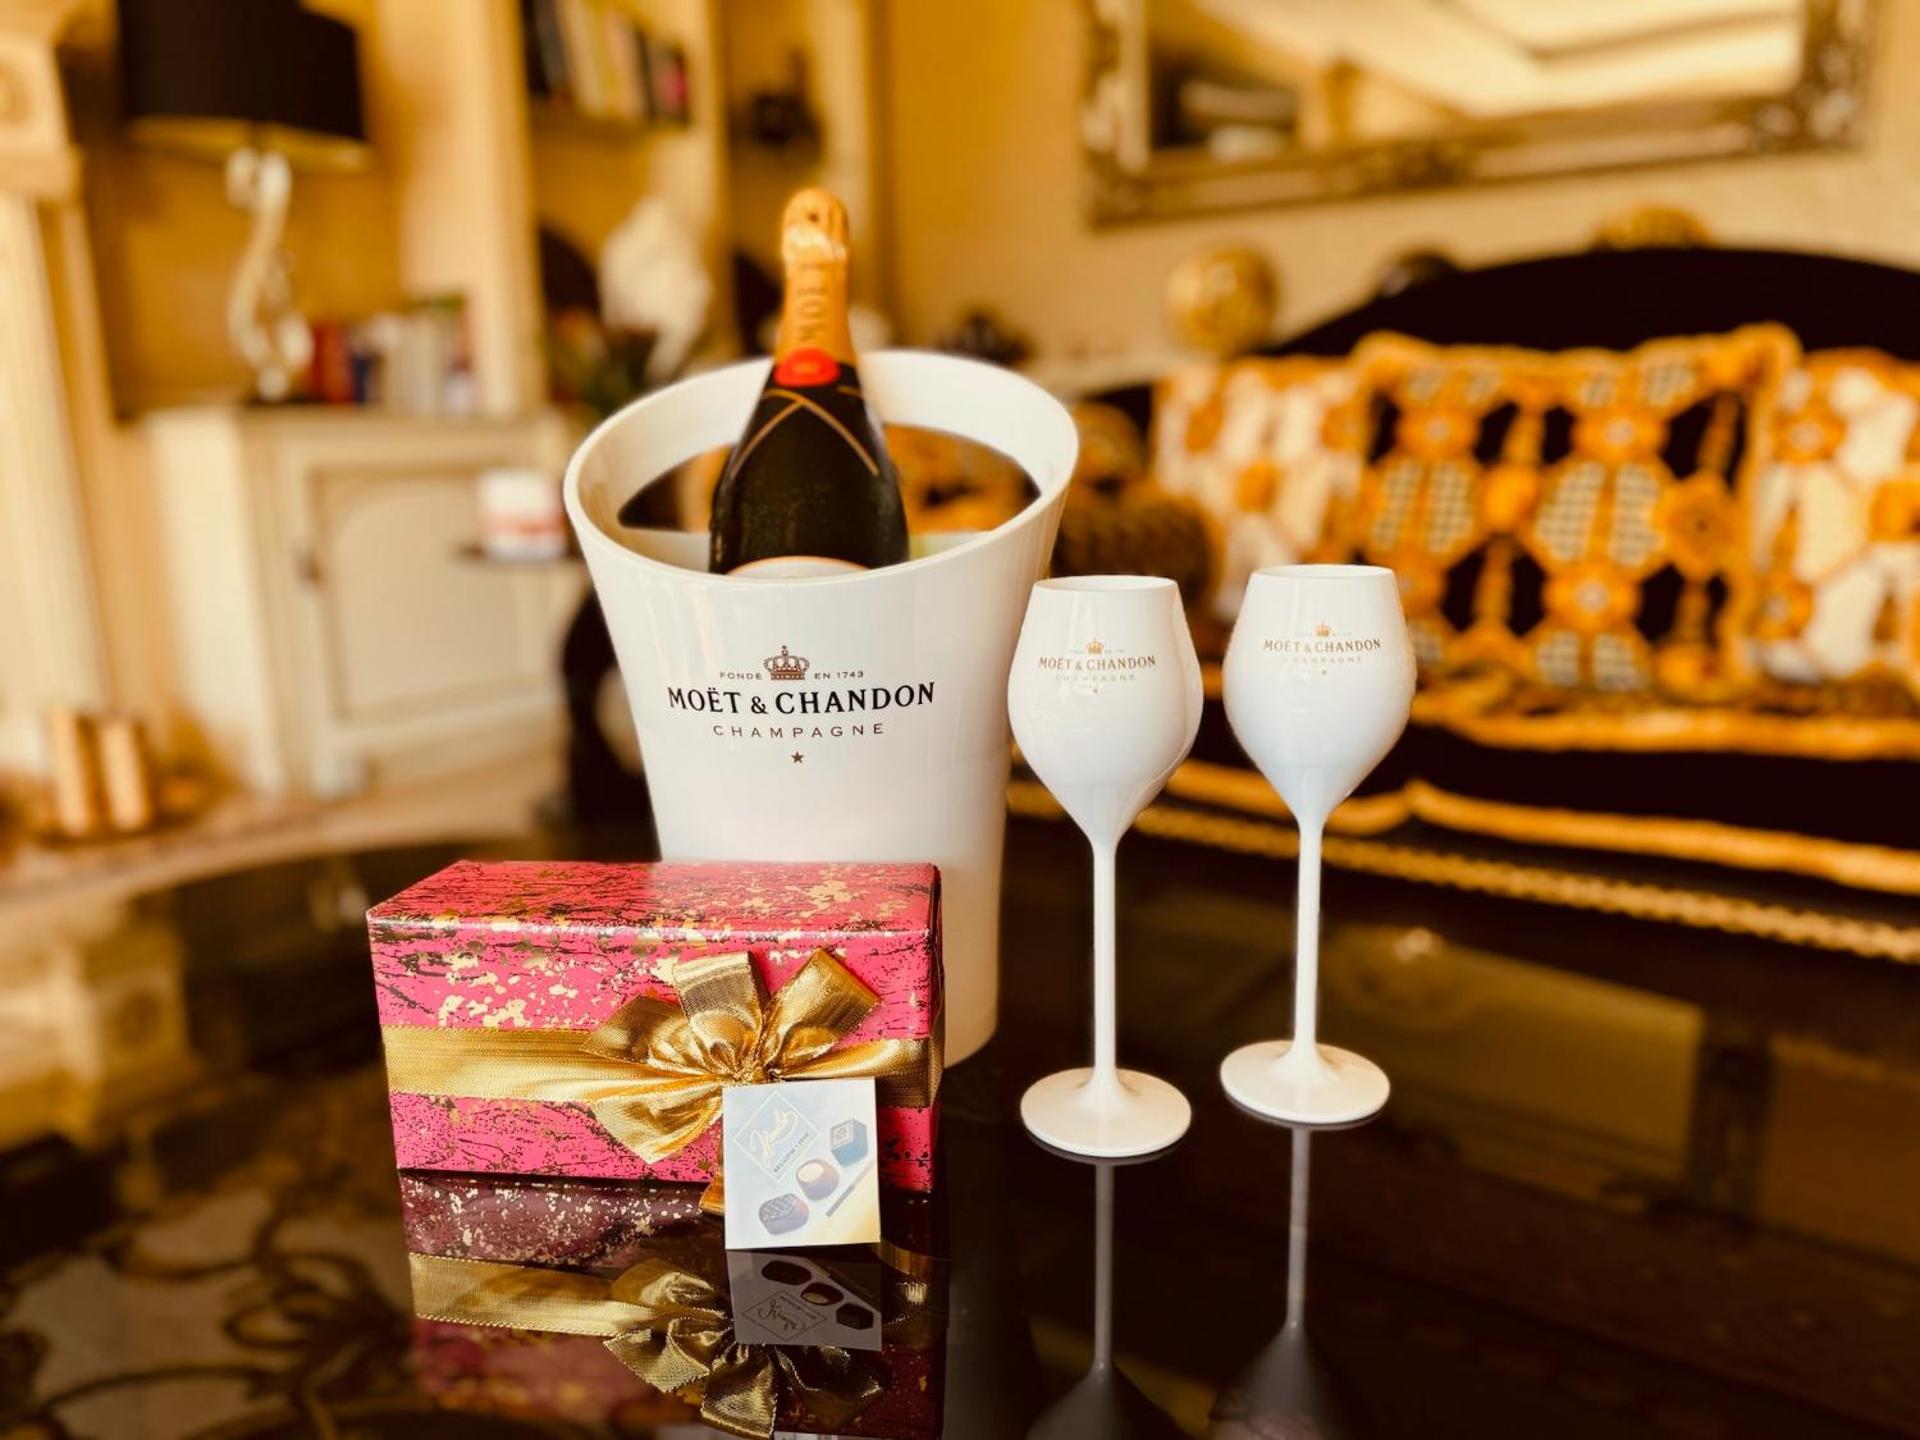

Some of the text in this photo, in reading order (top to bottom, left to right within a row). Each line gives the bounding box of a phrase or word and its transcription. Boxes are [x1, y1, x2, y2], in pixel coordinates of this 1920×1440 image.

[1315, 638, 1381, 653] CHANDON
[1074, 660, 1083, 671] &
[1086, 656, 1156, 671] CHANDON
[814, 671, 832, 680] EN
[836, 670, 864, 679] 1743
[667, 681, 936, 715] MOËT & CHANDON
[713, 722, 884, 739] CHAMPAGNE
